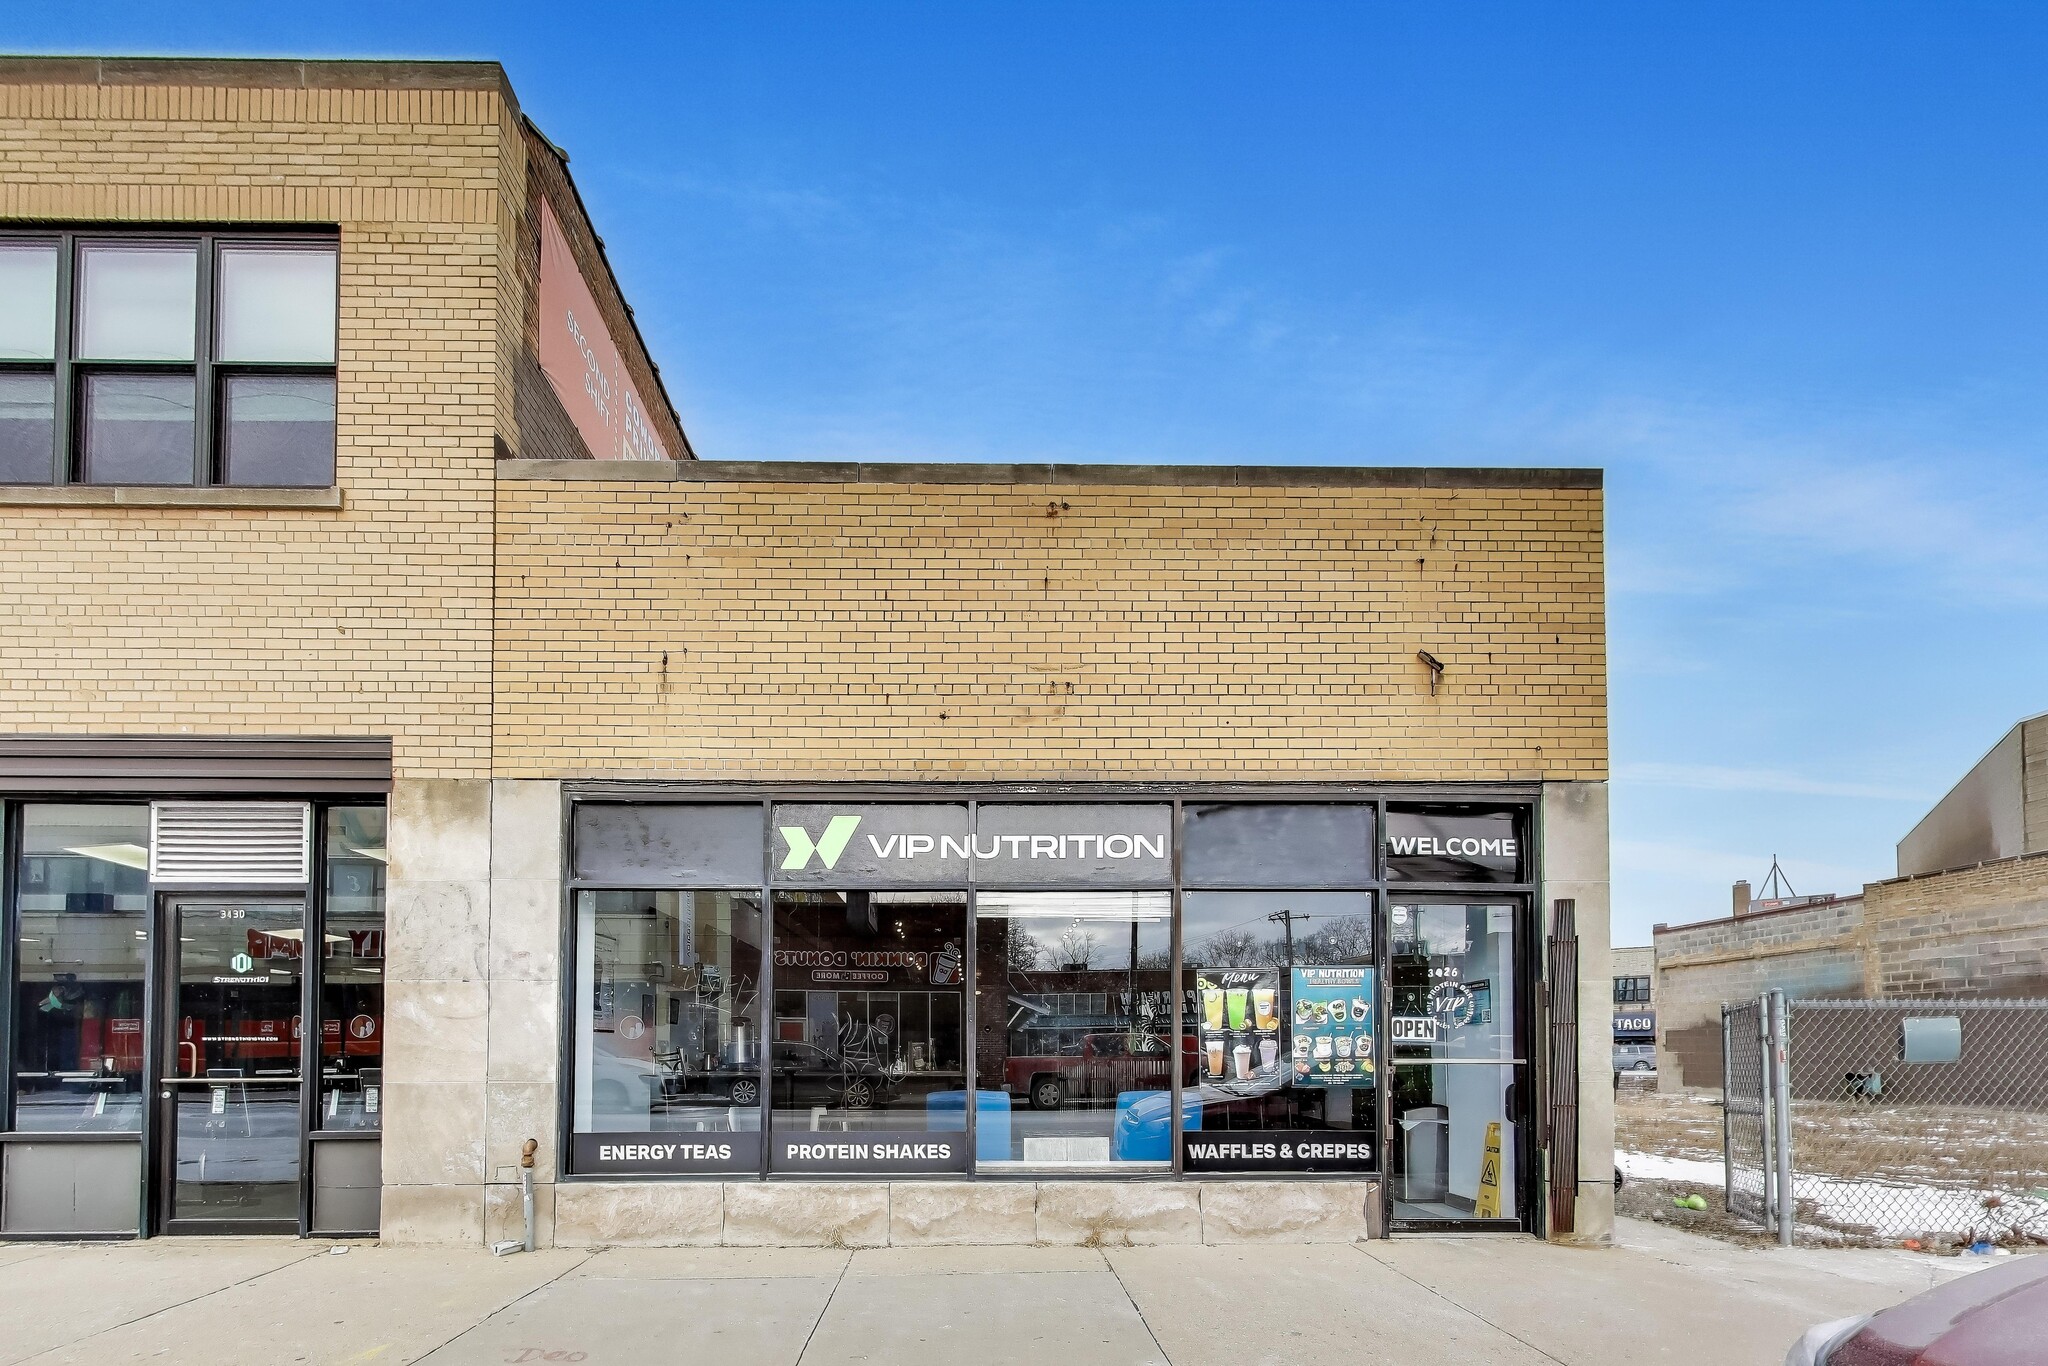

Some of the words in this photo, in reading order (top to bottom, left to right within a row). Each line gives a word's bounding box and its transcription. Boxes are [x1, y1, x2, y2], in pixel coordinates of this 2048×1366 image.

[567, 310, 610, 400] SECOND
[585, 372, 609, 427] SHIFT
[866, 834, 935, 860] VIP
[940, 833, 1165, 860] NUTRITION
[1390, 836, 1516, 858] WELCOME
[1221, 972, 1259, 989] Menu
[1300, 969, 1316, 978] VIP
[1318, 969, 1365, 978] NUTRITION
[1427, 981, 1459, 1000] PROTEIN
[1459, 985, 1473, 999] BAR
[1435, 996, 1465, 1013] VIP
[1392, 1019, 1435, 1039] OPEN
[599, 1144, 676, 1160] ENERGY
[680, 1144, 732, 1160] TEAS
[786, 1144, 869, 1160] PROTEIN
[873, 1143, 951, 1160] SHAKES
[1188, 1144, 1277, 1160] WAFFLES
[1279, 1143, 1294, 1160] &
[1297, 1143, 1371, 1160] CREPES
